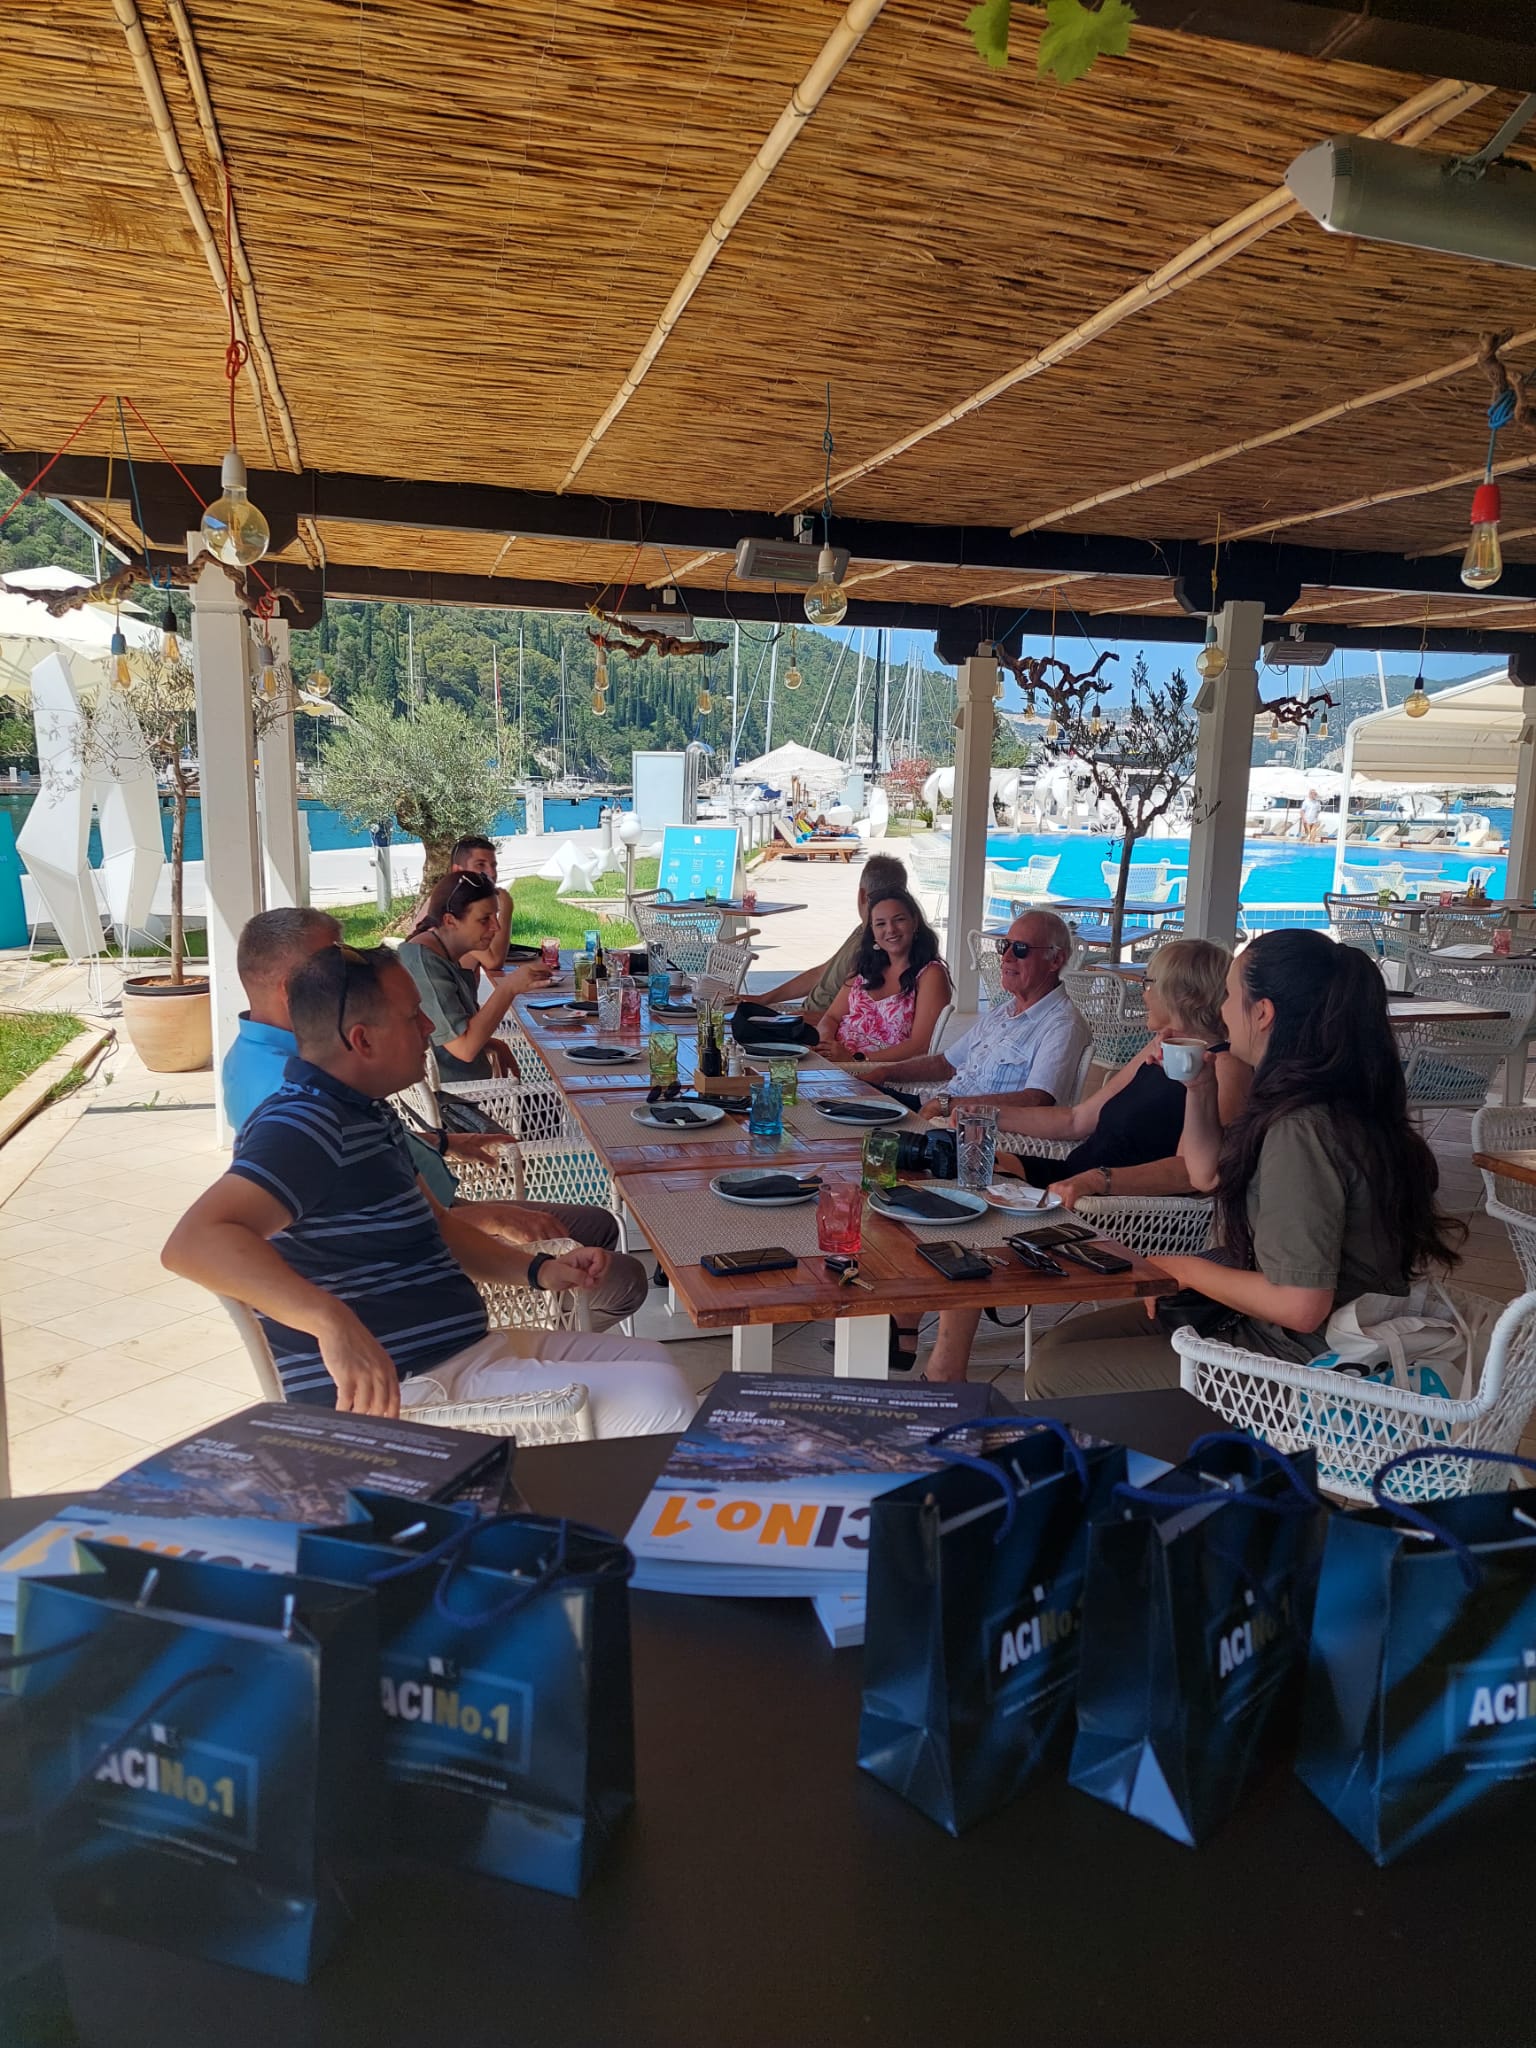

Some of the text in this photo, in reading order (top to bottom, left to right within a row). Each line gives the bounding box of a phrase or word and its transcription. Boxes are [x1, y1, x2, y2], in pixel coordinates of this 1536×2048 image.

[769, 1402, 918, 1420] GAME CHANGERS
[345, 1451, 398, 1466] GAME
[651, 1496, 869, 1549] CINo.1
